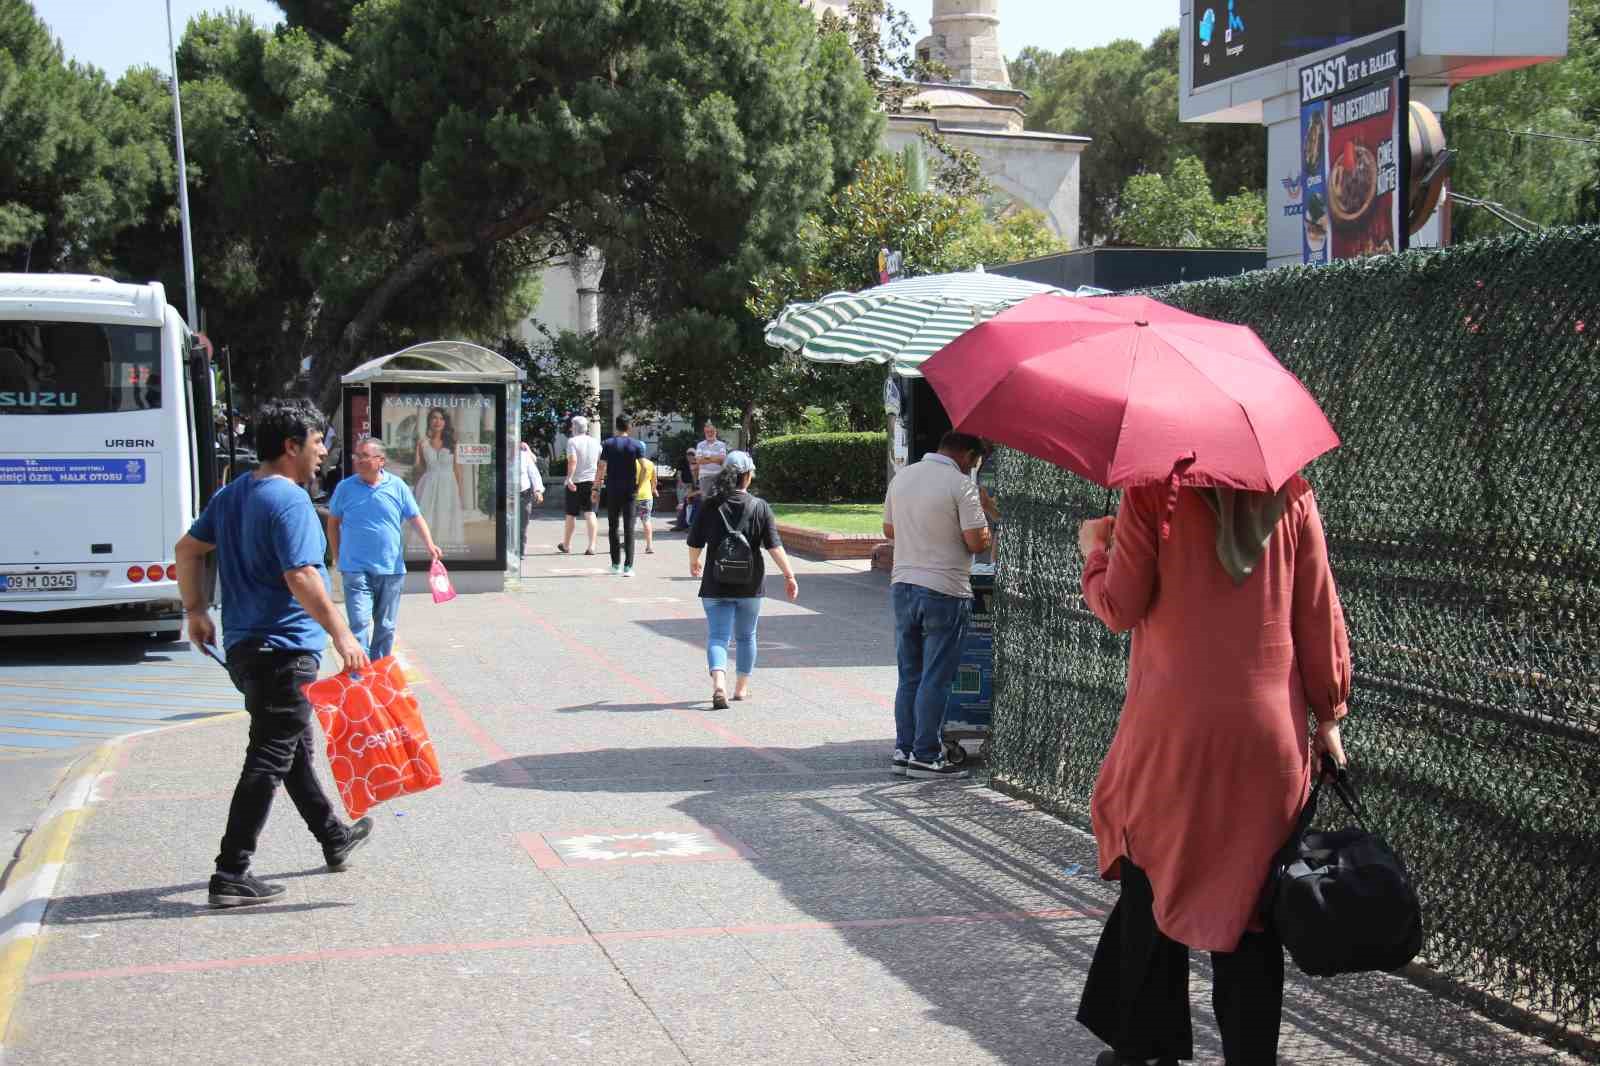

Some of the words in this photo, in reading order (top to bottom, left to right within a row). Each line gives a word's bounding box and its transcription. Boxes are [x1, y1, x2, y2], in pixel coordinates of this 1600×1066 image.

[1301, 55, 1346, 102] REST
[1347, 63, 1360, 82] ET
[1360, 60, 1369, 78] &
[1369, 48, 1397, 75] BALIK
[1346, 87, 1389, 121] RESTAURANT
[385, 397, 491, 409] KARABULUTLAR
[105, 439, 155, 448] URBAN
[28, 472, 55, 482] ÖZEL
[59, 473, 87, 482] HALK
[7, 576, 23, 588] 09
[26, 575, 37, 588] M
[42, 573, 74, 587] 0345
